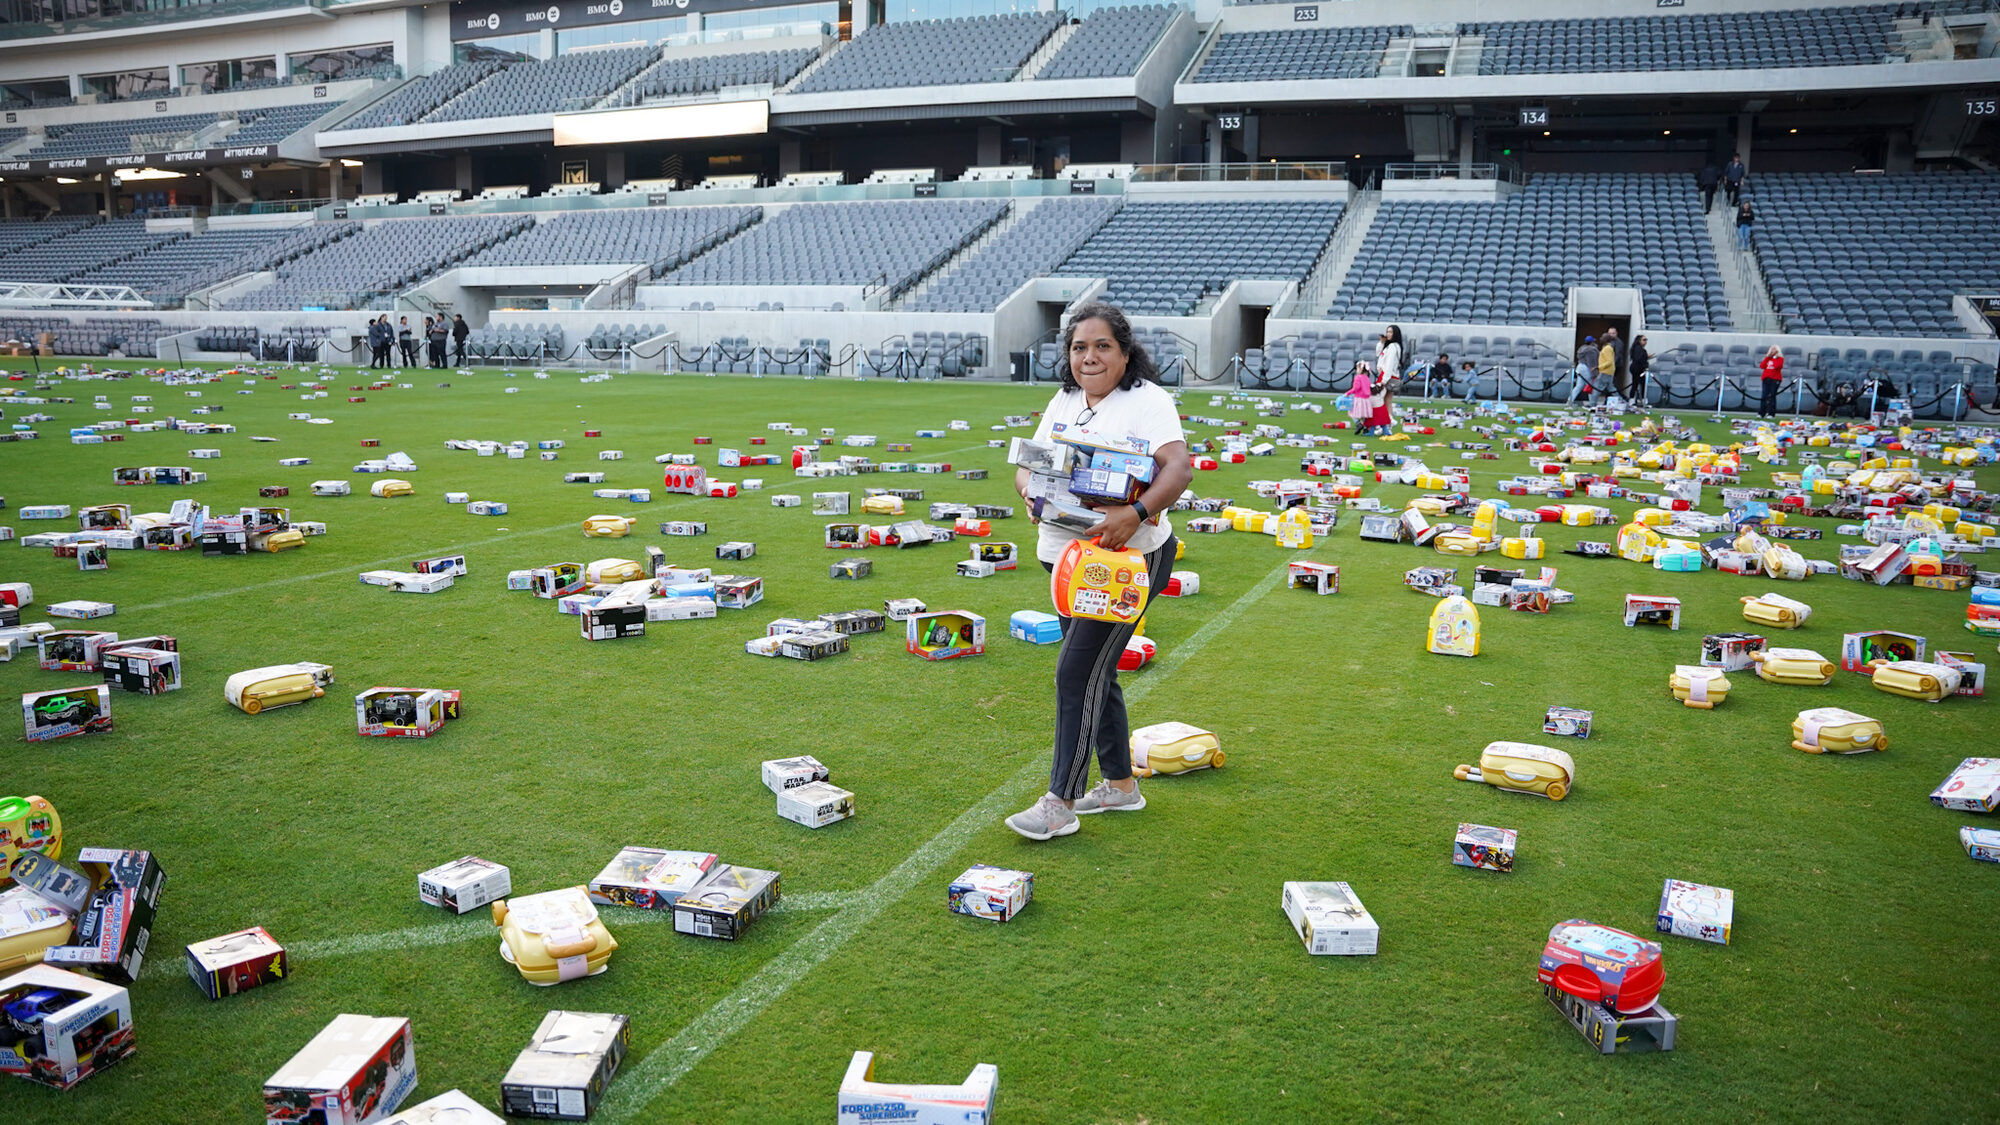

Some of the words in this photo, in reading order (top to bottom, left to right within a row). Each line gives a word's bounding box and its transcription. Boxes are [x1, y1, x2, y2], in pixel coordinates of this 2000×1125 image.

[588, 4, 608, 15] BMO
[1296, 9, 1317, 20] 233
[526, 11, 546, 22] BMO
[467, 18, 487, 29] BMO
[315, 88, 326, 97] 229
[1966, 101, 1996, 115] 135
[1219, 117, 1241, 129] 133
[1523, 112, 1546, 124] 134
[241, 170, 253, 178] 129
[29, 730, 49, 739] FORD
[786, 776, 806, 784] STAR
[817, 807, 834, 817] WARS
[818, 803, 834, 812] STAR
[421, 881, 436, 891] STAR
[422, 887, 438, 898] WARS
[112, 893, 124, 923] TRUCK
[82, 910, 99, 937] POLICE
[106, 905, 115, 932] F-150
[110, 922, 121, 952] POLICE
[101, 932, 113, 960] FORD
[60, 1017, 81, 1035] FORD
[841, 1104, 874, 1114] FORD
[874, 1102, 906, 1112] F-250
[859, 1111, 892, 1120] SUPER
[892, 1109, 919, 1119] DUTY
